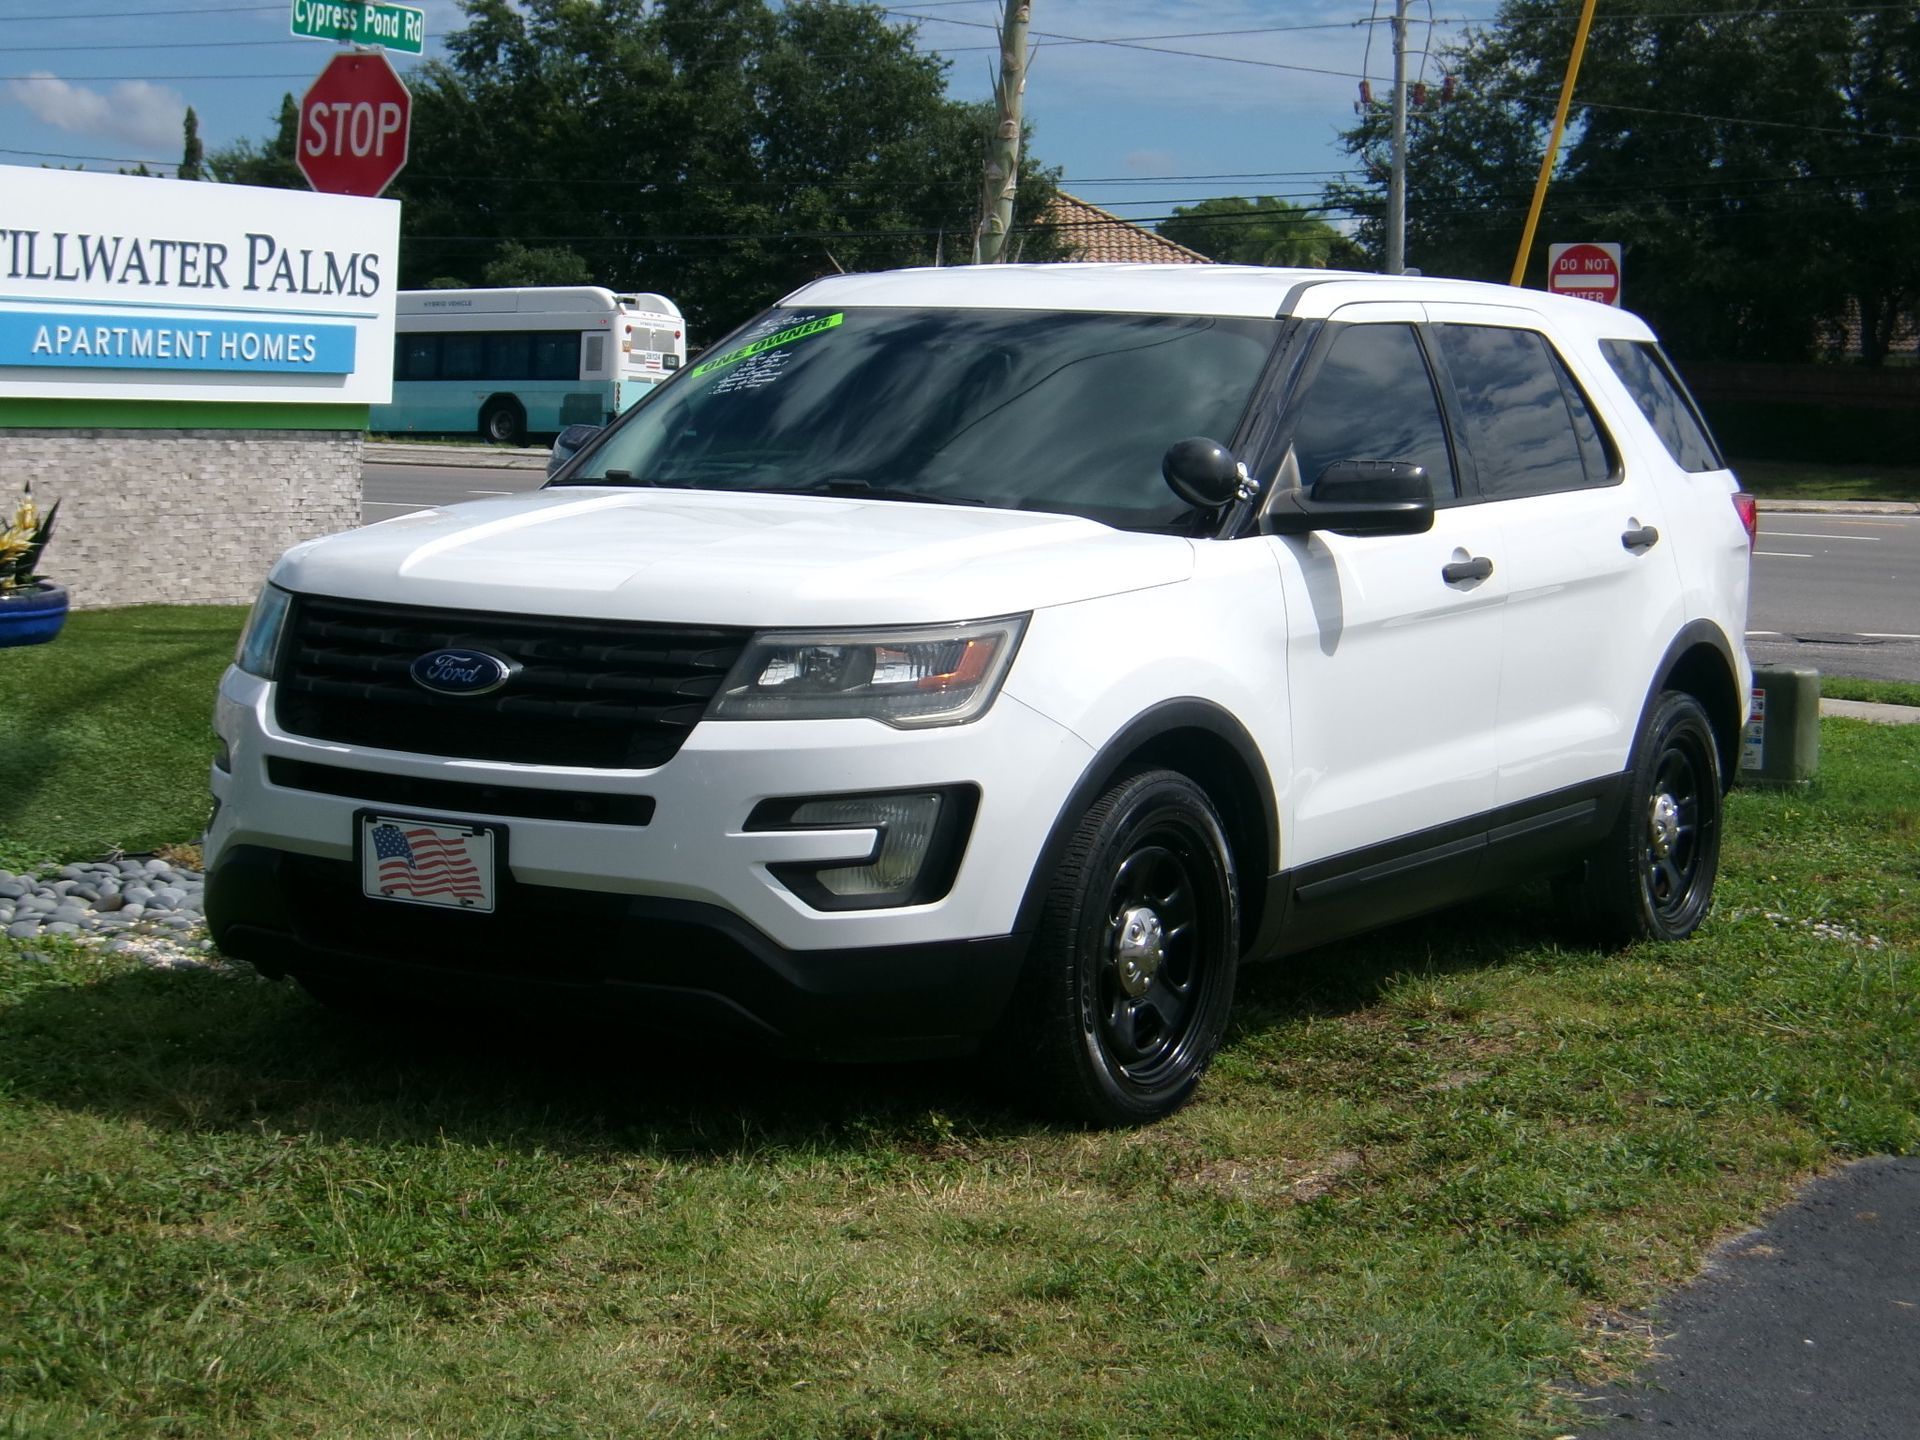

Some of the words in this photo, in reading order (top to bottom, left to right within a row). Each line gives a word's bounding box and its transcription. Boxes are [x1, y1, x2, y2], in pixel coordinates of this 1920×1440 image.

[295, 0, 358, 33] Cypress
[364, 5, 399, 38] Pond
[405, 11, 421, 42] Rd
[306, 102, 401, 157] STOP
[243, 232, 380, 298] PALMS
[1560, 258, 1577, 270] DO
[1585, 258, 1610, 270] NOT
[1564, 291, 1604, 303] NTER
[32, 324, 212, 360] APARTMENT
[220, 331, 317, 363] HOMES
[701, 347, 748, 372] ONE
[750, 317, 833, 352] OWNER
[427, 654, 482, 682] Ford
